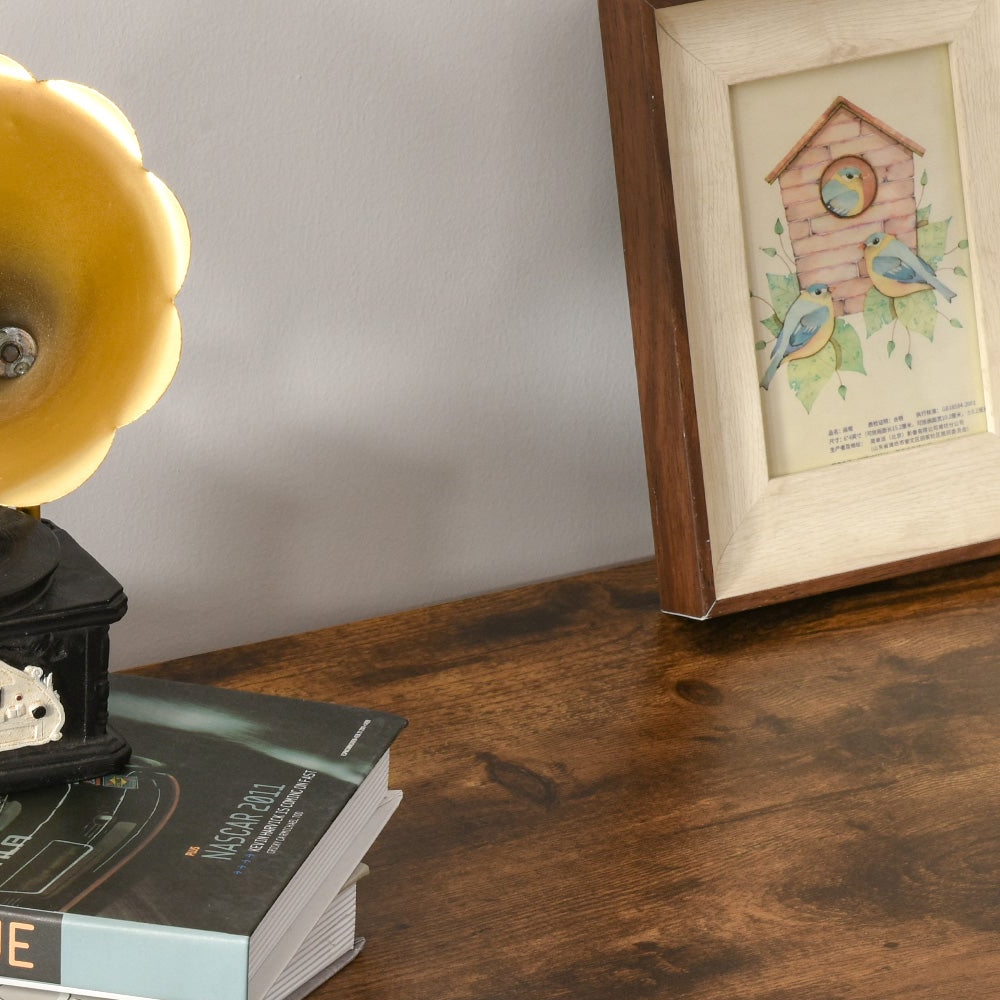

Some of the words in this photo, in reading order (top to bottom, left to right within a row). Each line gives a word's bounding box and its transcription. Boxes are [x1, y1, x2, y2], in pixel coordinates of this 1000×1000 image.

[201, 812, 263, 860] NASCAR
[237, 783, 286, 812] 2011
[249, 836, 269, 852] KEVIN
[260, 815, 284, 836] HARVICK
[281, 790, 303, 807] COMING
[299, 770, 317, 782] FAST
